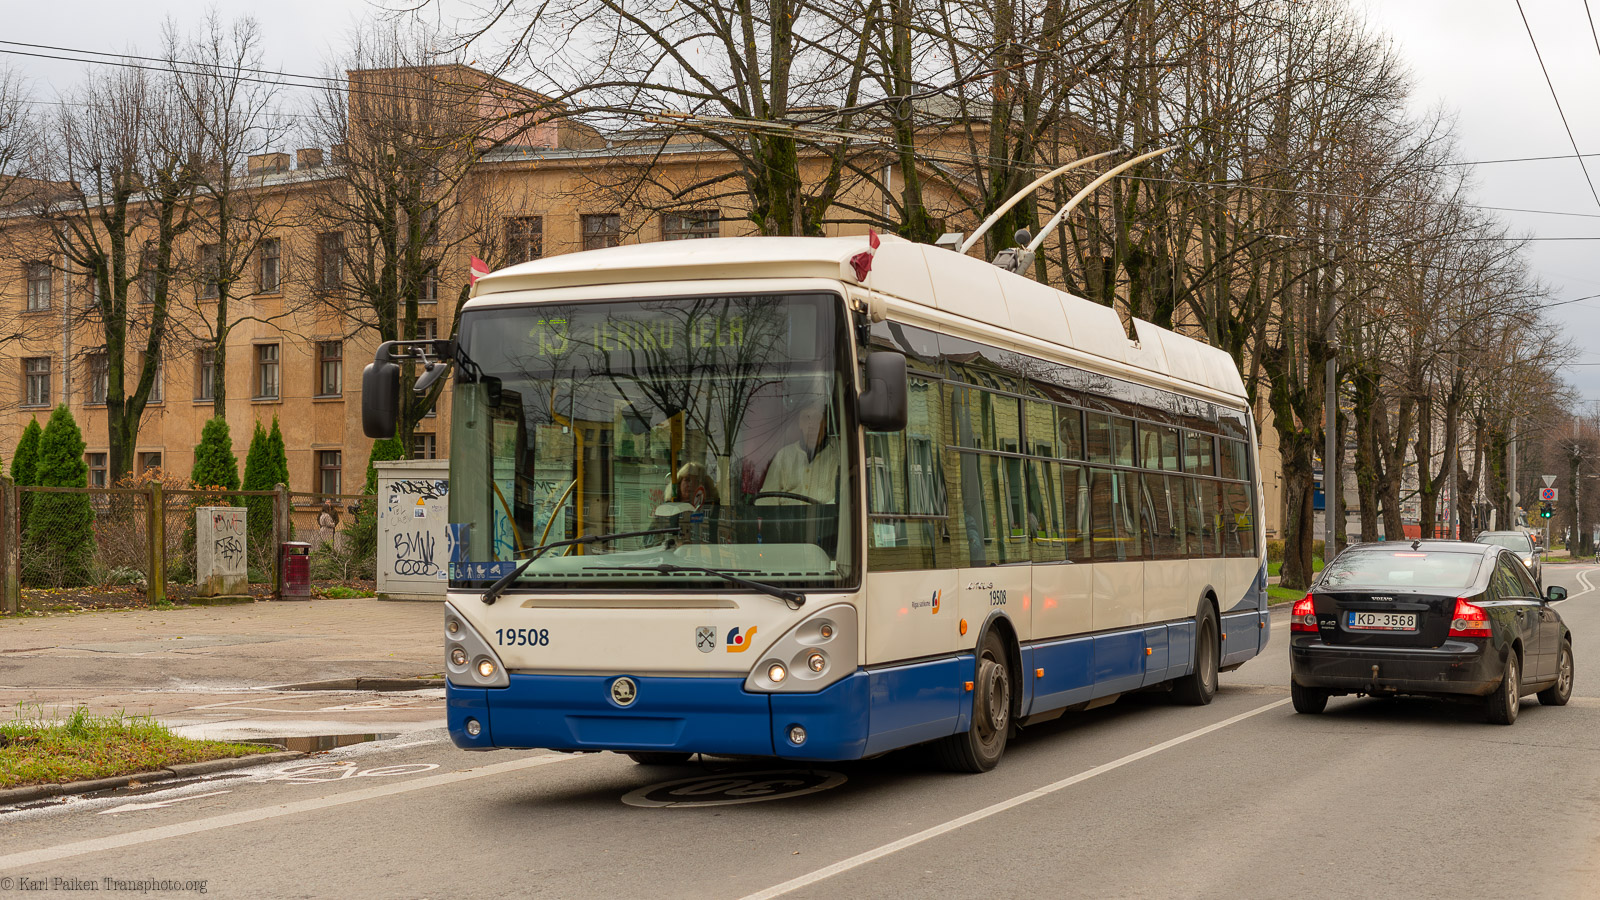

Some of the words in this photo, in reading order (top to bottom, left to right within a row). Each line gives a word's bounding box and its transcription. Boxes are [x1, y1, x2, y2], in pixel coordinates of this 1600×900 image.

[529, 319, 569, 355] 13
[690, 317, 744, 348] IELA
[394, 530, 435, 565] BMW
[989, 589, 1007, 606] 19508
[1357, 613, 1414, 626] KD-3568
[495, 628, 550, 646] 19508
